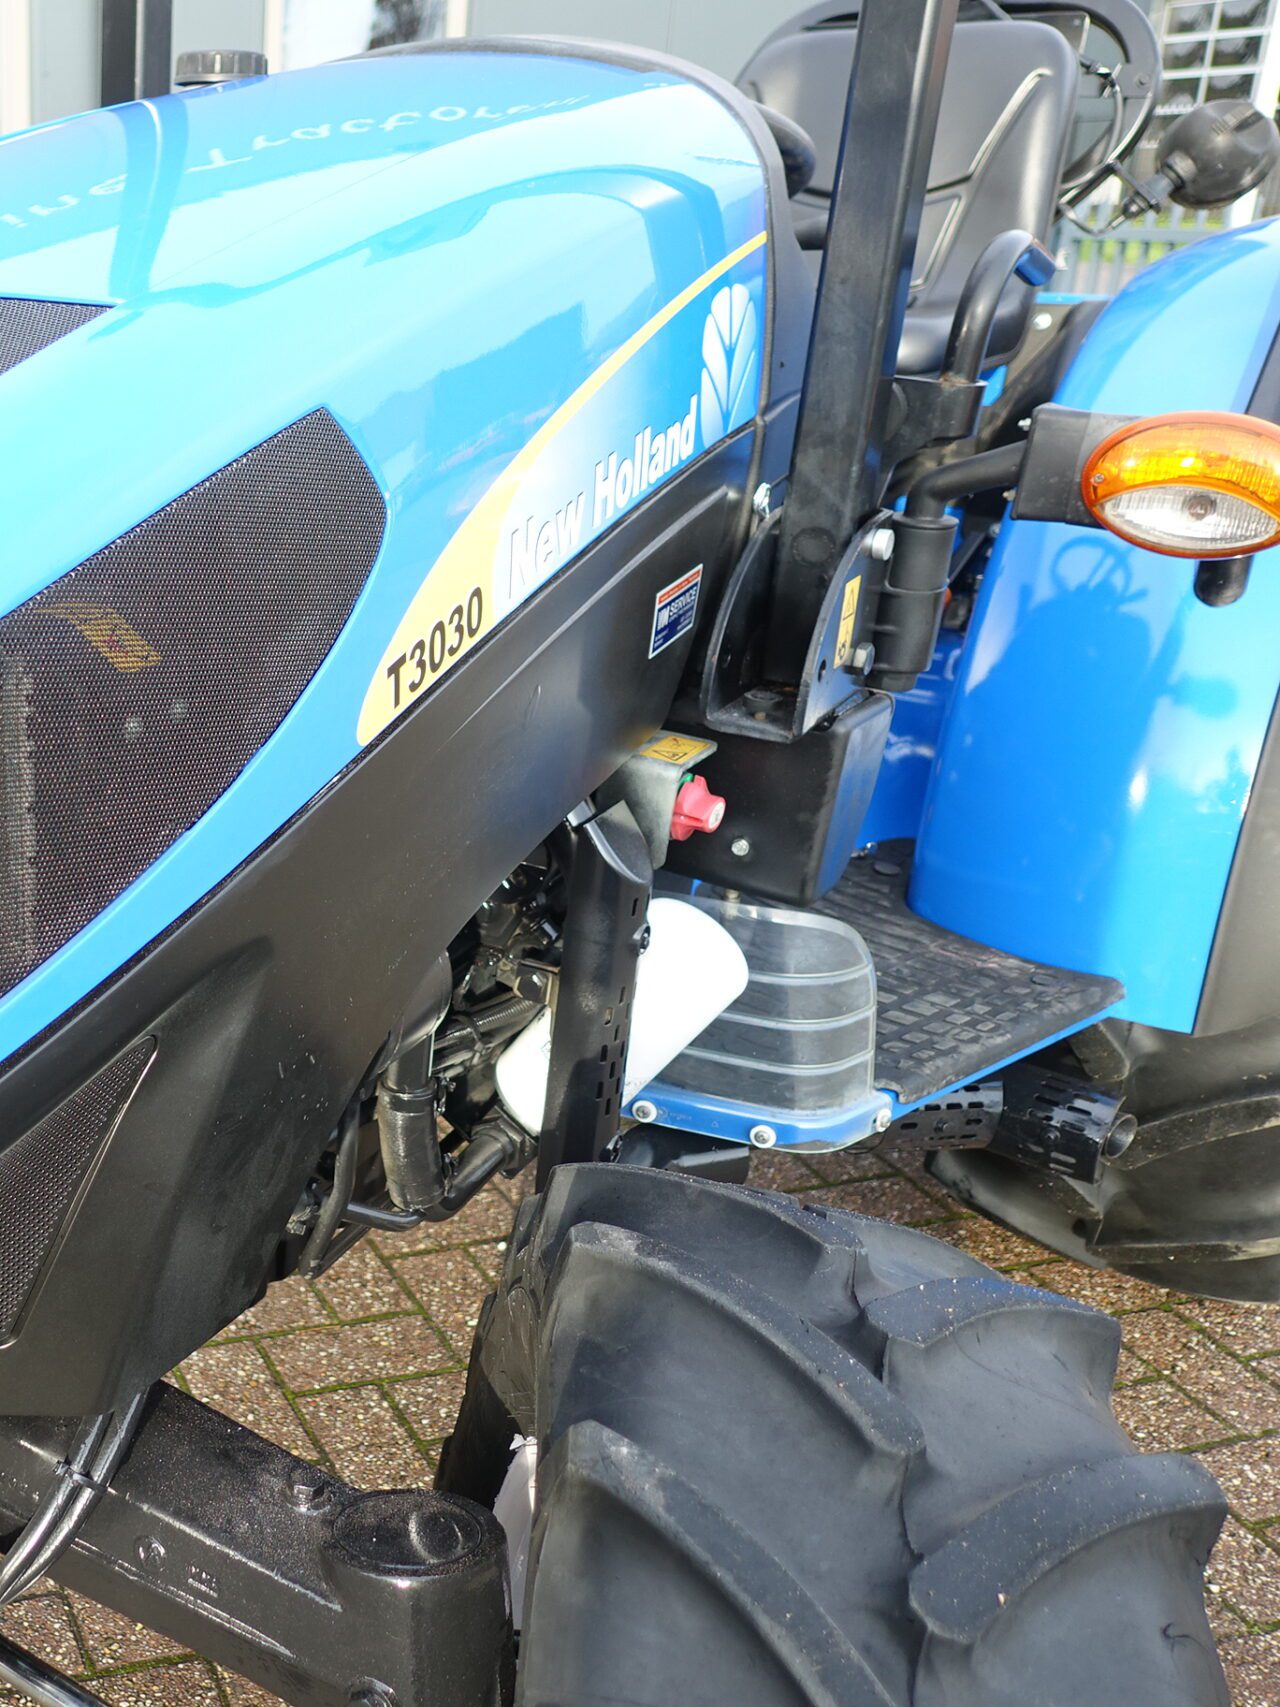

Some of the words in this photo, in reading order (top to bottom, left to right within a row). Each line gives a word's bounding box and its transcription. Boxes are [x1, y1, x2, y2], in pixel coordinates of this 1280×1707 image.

[508, 491, 586, 599] New
[591, 393, 698, 528] Holland
[386, 586, 483, 709] T3030
